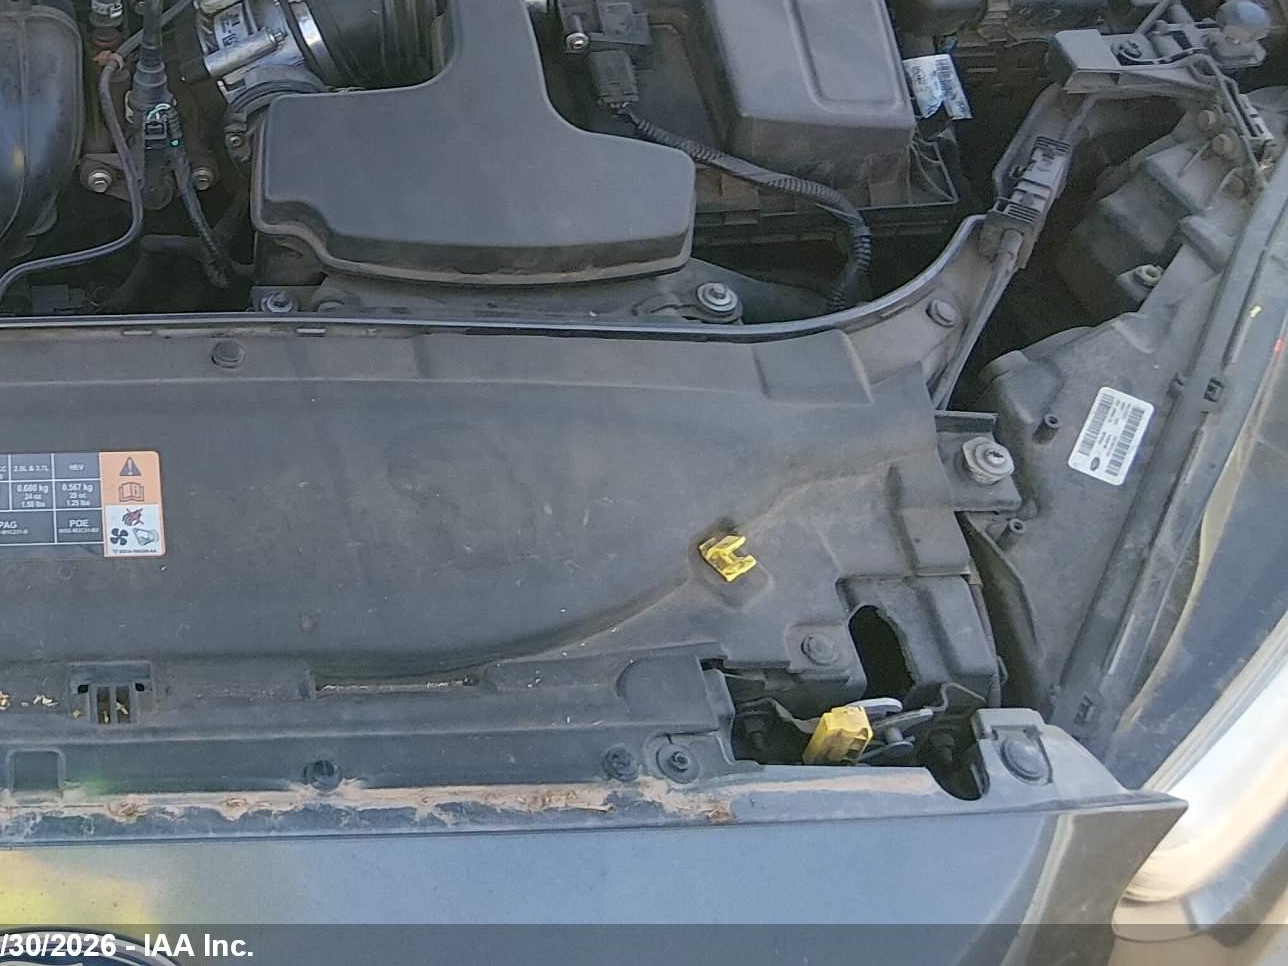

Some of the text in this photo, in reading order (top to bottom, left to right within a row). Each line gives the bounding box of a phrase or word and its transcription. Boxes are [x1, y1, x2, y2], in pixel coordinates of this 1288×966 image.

[39, 483, 49, 494] kg
[83, 483, 93, 493] kg
[69, 519, 90, 527] POE
